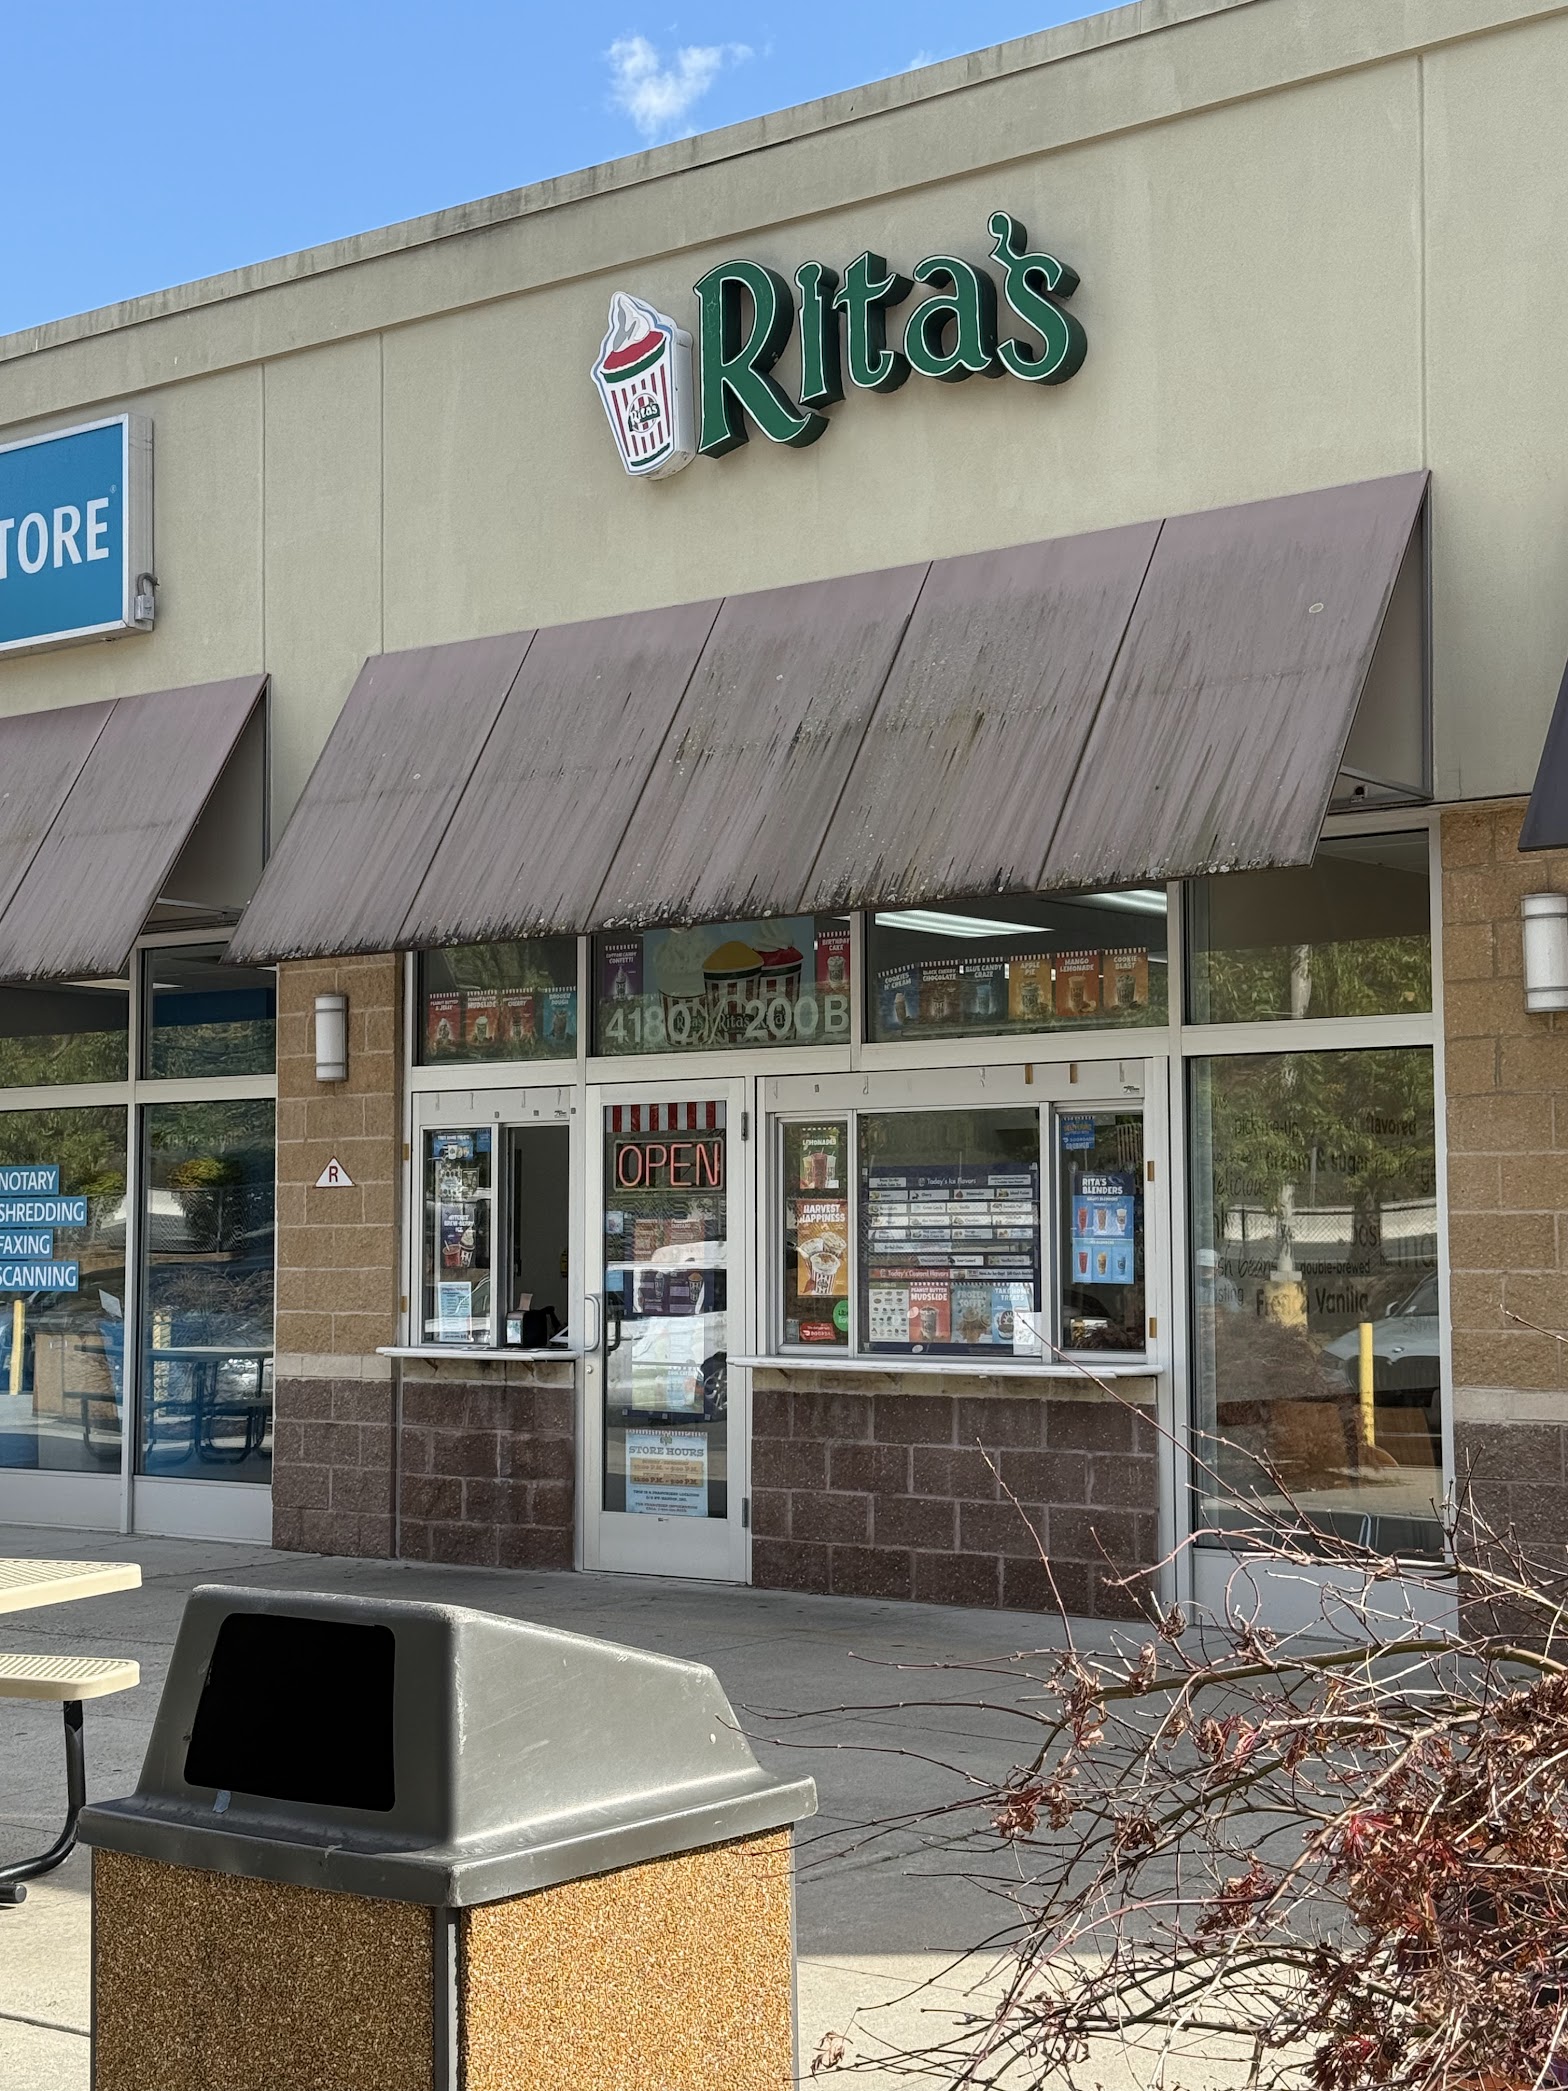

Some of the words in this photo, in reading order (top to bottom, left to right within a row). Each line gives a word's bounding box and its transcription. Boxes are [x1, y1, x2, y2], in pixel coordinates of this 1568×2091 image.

[693, 211, 1087, 459] Rita's
[630, 402, 658, 427] Rita's
[1064, 957, 1089, 965] MANGO
[981, 964, 1002, 972] CANDY
[1060, 964, 1094, 973] LEMONADE
[1115, 962, 1136, 970] BLAST
[974, 971, 994, 979] CRAZE
[1025, 968, 1036, 976] PIE
[884, 972, 909, 984] COOKIES
[922, 974, 957, 982] CHOCOLATE
[891, 978, 912, 990] CREAM
[467, 1000, 497, 1009] MUDSLIDE
[605, 1003, 691, 1043] 4180
[744, 994, 850, 1038] 200B
[1366, 1112, 1417, 1136] flavored
[618, 1143, 719, 1187] OPEN
[329, 1166, 338, 1183] R
[0, 1171, 56, 1191] NOTARY
[927, 1178, 947, 1186] Today's
[1082, 1178, 1107, 1186] RITA'S
[1082, 1186, 1123, 1195] BLENDERS
[803, 1204, 841, 1214] HARVEST
[1298, 1255, 1372, 1275] double-brewed
[888, 1269, 907, 1278] Today's
[911, 1293, 948, 1301] MUDSLIDE
[957, 1291, 987, 1299] FROZEN
[1315, 1285, 1369, 1314] Vanilla
[629, 1445, 664, 1455] STORE
[666, 1448, 704, 1457] HOURS
